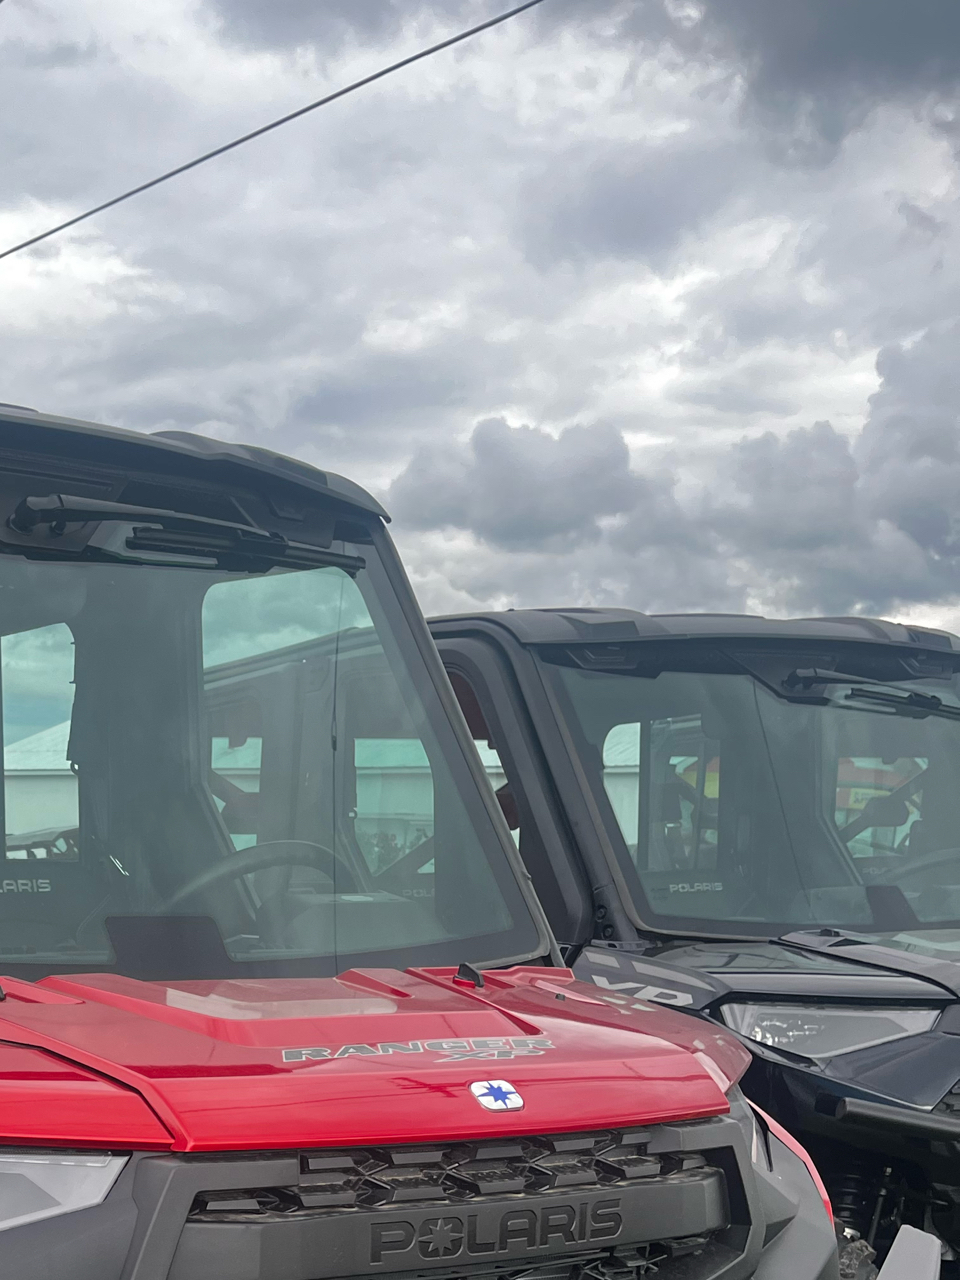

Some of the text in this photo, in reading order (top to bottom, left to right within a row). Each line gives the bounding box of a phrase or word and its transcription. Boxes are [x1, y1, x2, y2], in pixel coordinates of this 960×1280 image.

[669, 882, 723, 893] POLARIS
[282, 1038, 556, 1062] RANGER
[433, 1049, 545, 1062] XP
[369, 1198, 623, 1265] POLARIS
